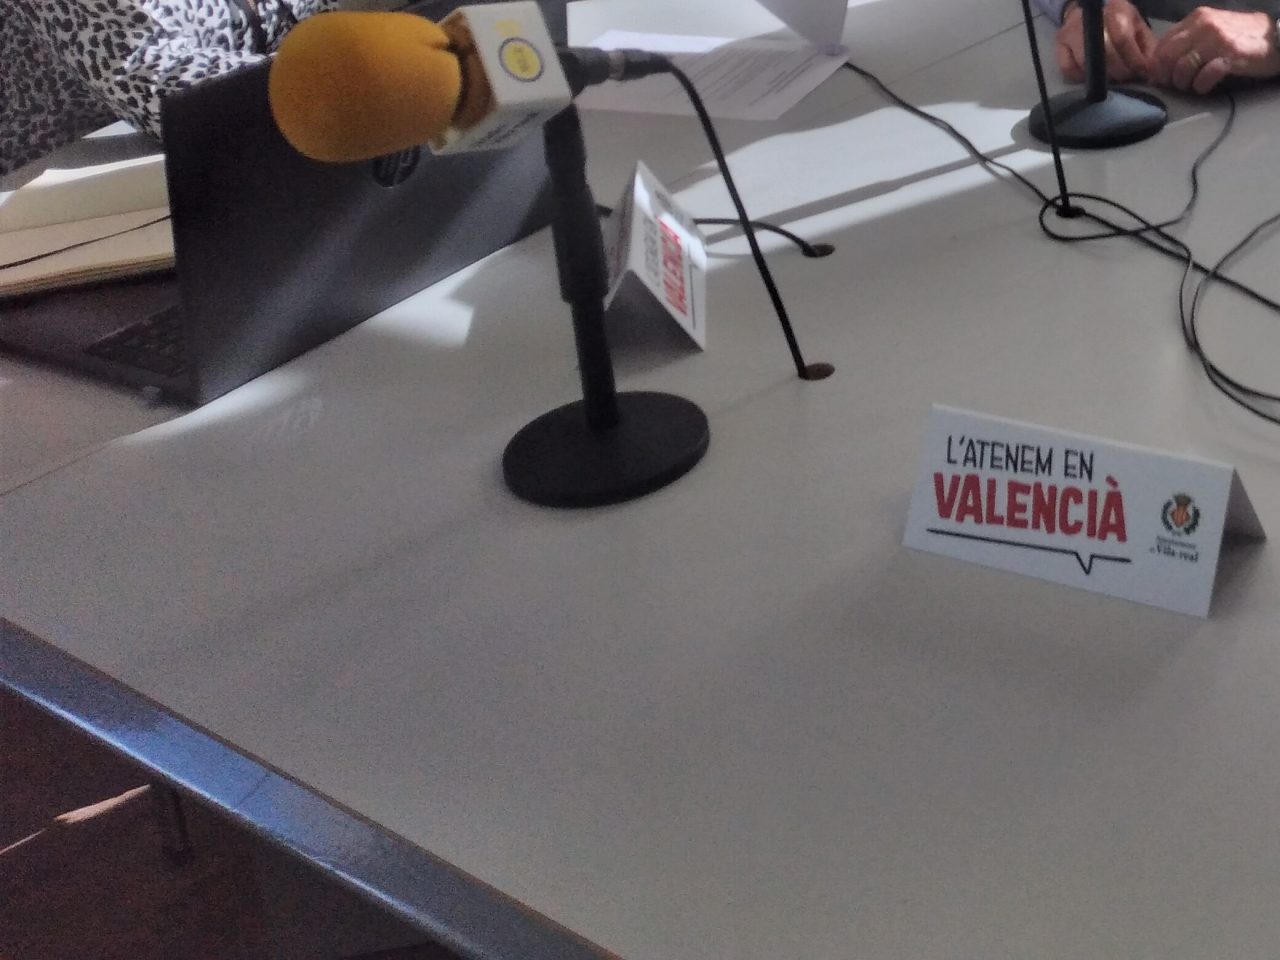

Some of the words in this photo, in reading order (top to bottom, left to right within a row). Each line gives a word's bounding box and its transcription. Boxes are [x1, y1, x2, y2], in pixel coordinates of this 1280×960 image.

[946, 435, 1053, 476] L'ATENEM
[1064, 448, 1094, 482] EN
[933, 471, 1127, 543] VALENCIÀ
